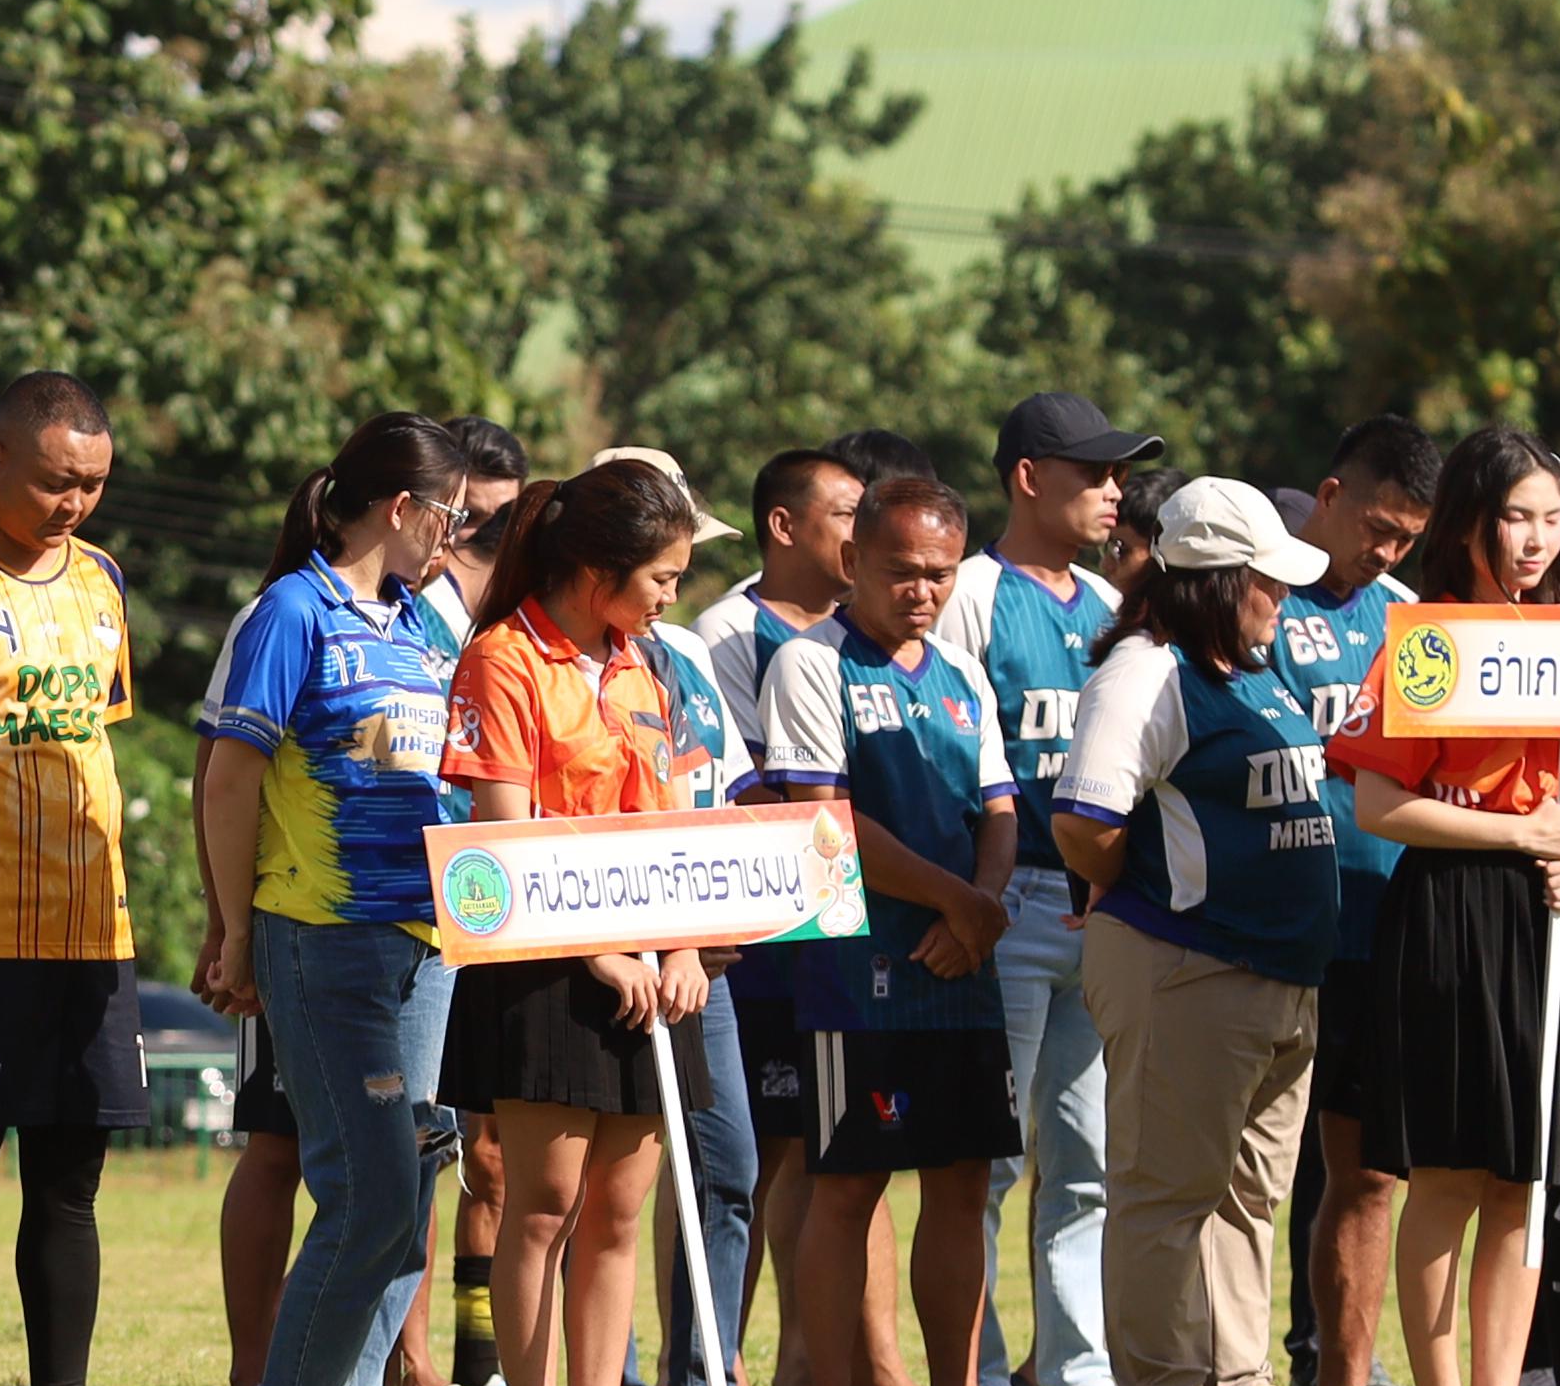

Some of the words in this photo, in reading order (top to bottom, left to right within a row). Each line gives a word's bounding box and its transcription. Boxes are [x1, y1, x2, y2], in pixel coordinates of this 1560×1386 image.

[16, 663, 102, 703] DOPA
[329, 641, 376, 687] 12
[1245, 745, 1327, 809] DOP
[1269, 815, 1337, 852] MAES
[521, 852, 806, 915] หน่วยเฉพาะกิจราชมนู
